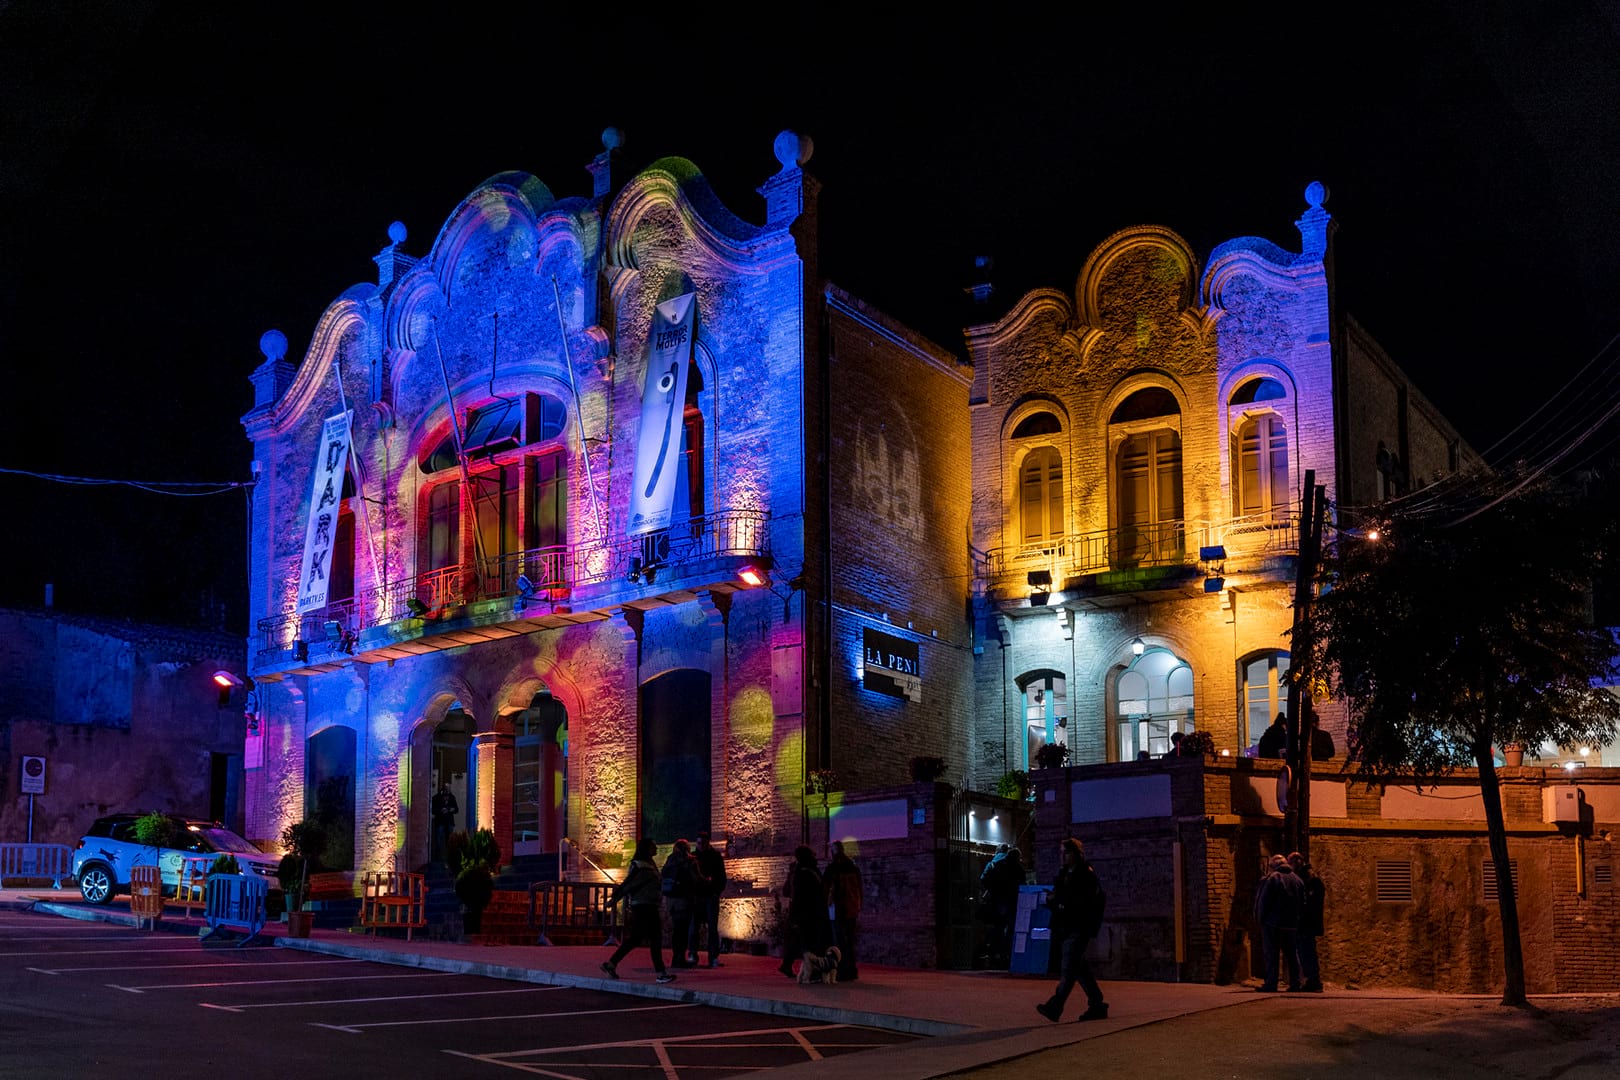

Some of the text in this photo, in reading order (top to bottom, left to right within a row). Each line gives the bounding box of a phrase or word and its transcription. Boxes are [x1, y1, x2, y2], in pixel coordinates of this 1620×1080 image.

[656, 325, 688, 341] TERROR
[307, 440, 345, 592] DARK
[867, 648, 917, 674] LA PENI
